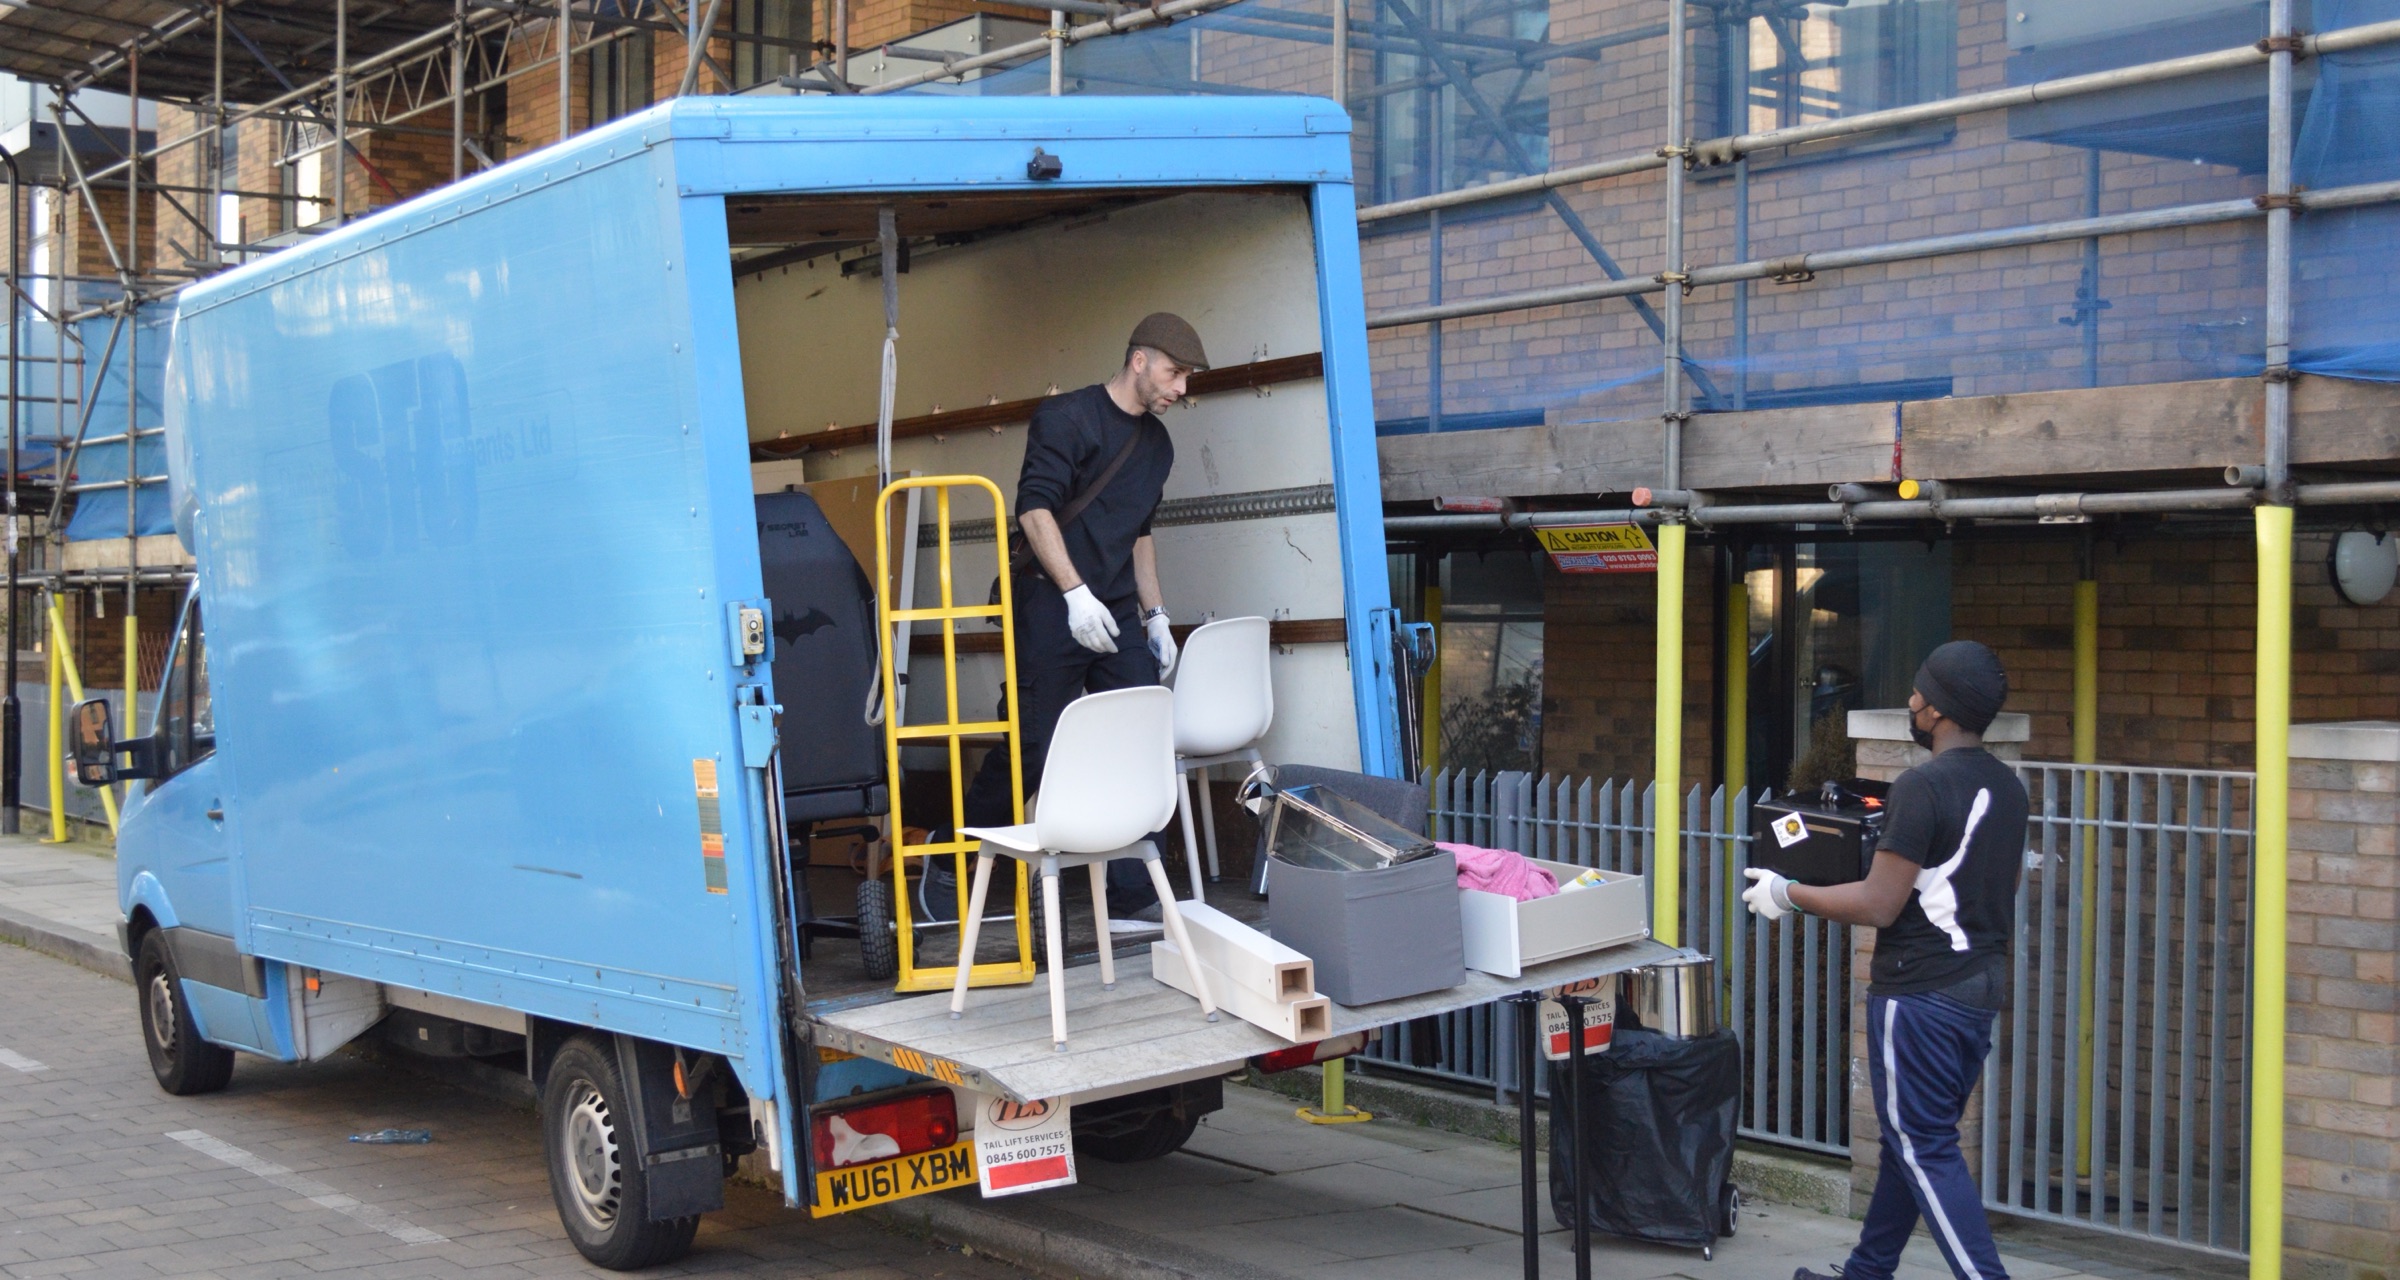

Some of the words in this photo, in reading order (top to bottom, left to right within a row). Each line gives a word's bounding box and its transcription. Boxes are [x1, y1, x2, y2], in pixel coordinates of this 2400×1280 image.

[1565, 531, 1620, 542] CAUTION
[1547, 1012, 1561, 1020] TAIL
[1584, 1002, 1610, 1012] ERVICES
[1591, 1013, 1612, 1024] 7575
[995, 1098, 1049, 1122] TLS
[984, 1142, 1003, 1150] TAIL
[1005, 1137, 1022, 1146] LIFT
[1025, 1131, 1064, 1143] SERVICES
[986, 1152, 1014, 1165] 0845
[1017, 1148, 1037, 1160] 600
[1039, 1143, 1066, 1156] 7575
[830, 1163, 900, 1207] WU61
[908, 1148, 971, 1191] XBM
